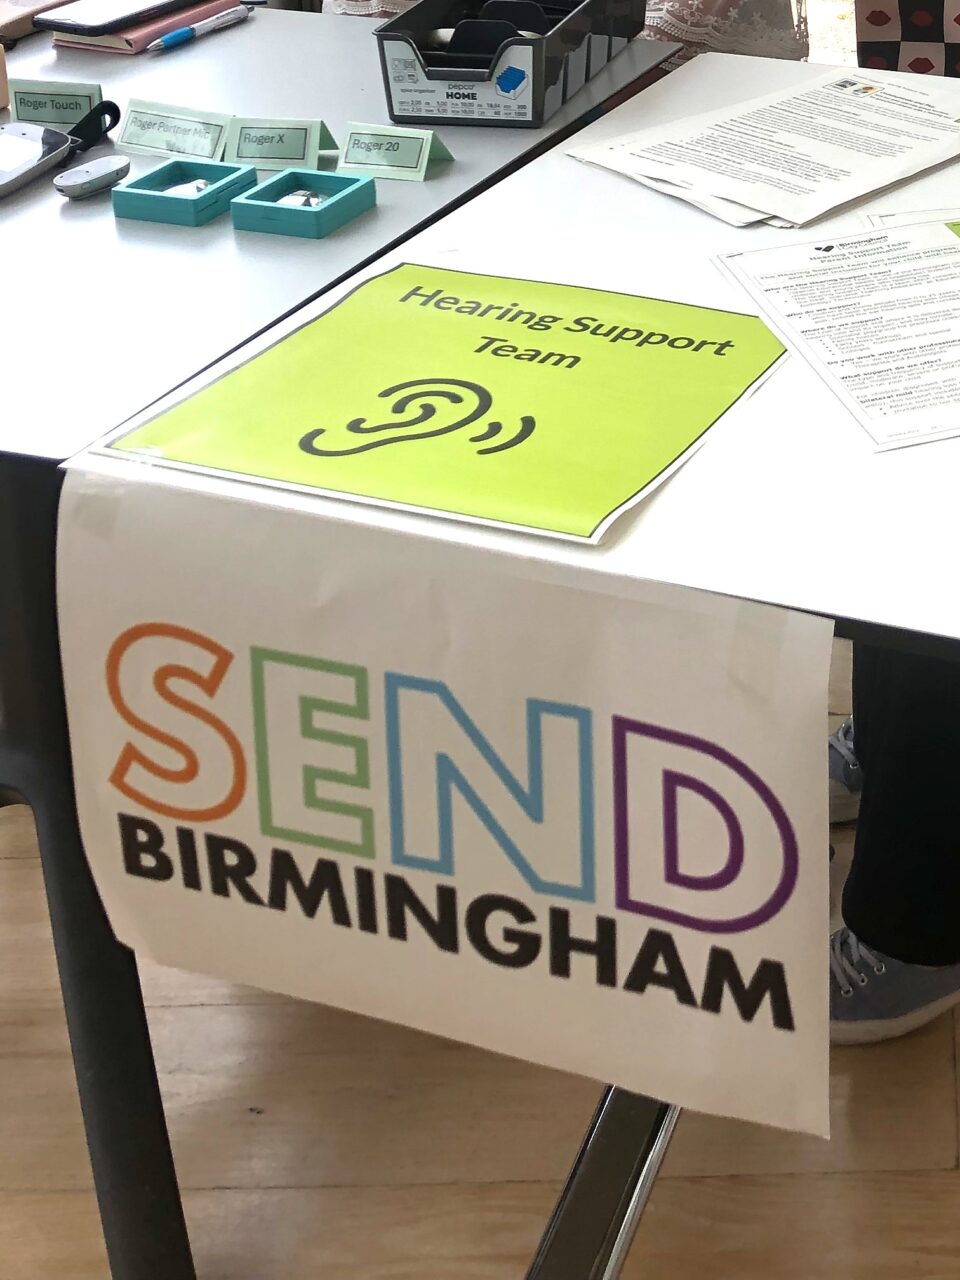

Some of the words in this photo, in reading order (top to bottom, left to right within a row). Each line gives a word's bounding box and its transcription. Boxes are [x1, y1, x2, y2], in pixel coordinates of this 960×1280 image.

[446, 92, 478, 100] HOME
[19, 98, 47, 111] Roger
[51, 99, 82, 111] Touch
[130, 117, 157, 131] Roger
[243, 133, 275, 145] Roger
[276, 133, 285, 144] X
[352, 138, 384, 152] Roger
[385, 141, 400, 152] 20
[398, 285, 564, 332] Hearing
[563, 316, 736, 356] Support
[472, 335, 583, 369] Team
[105, 621, 800, 935] SEND
[117, 812, 796, 1032] BIRMINGHAM
